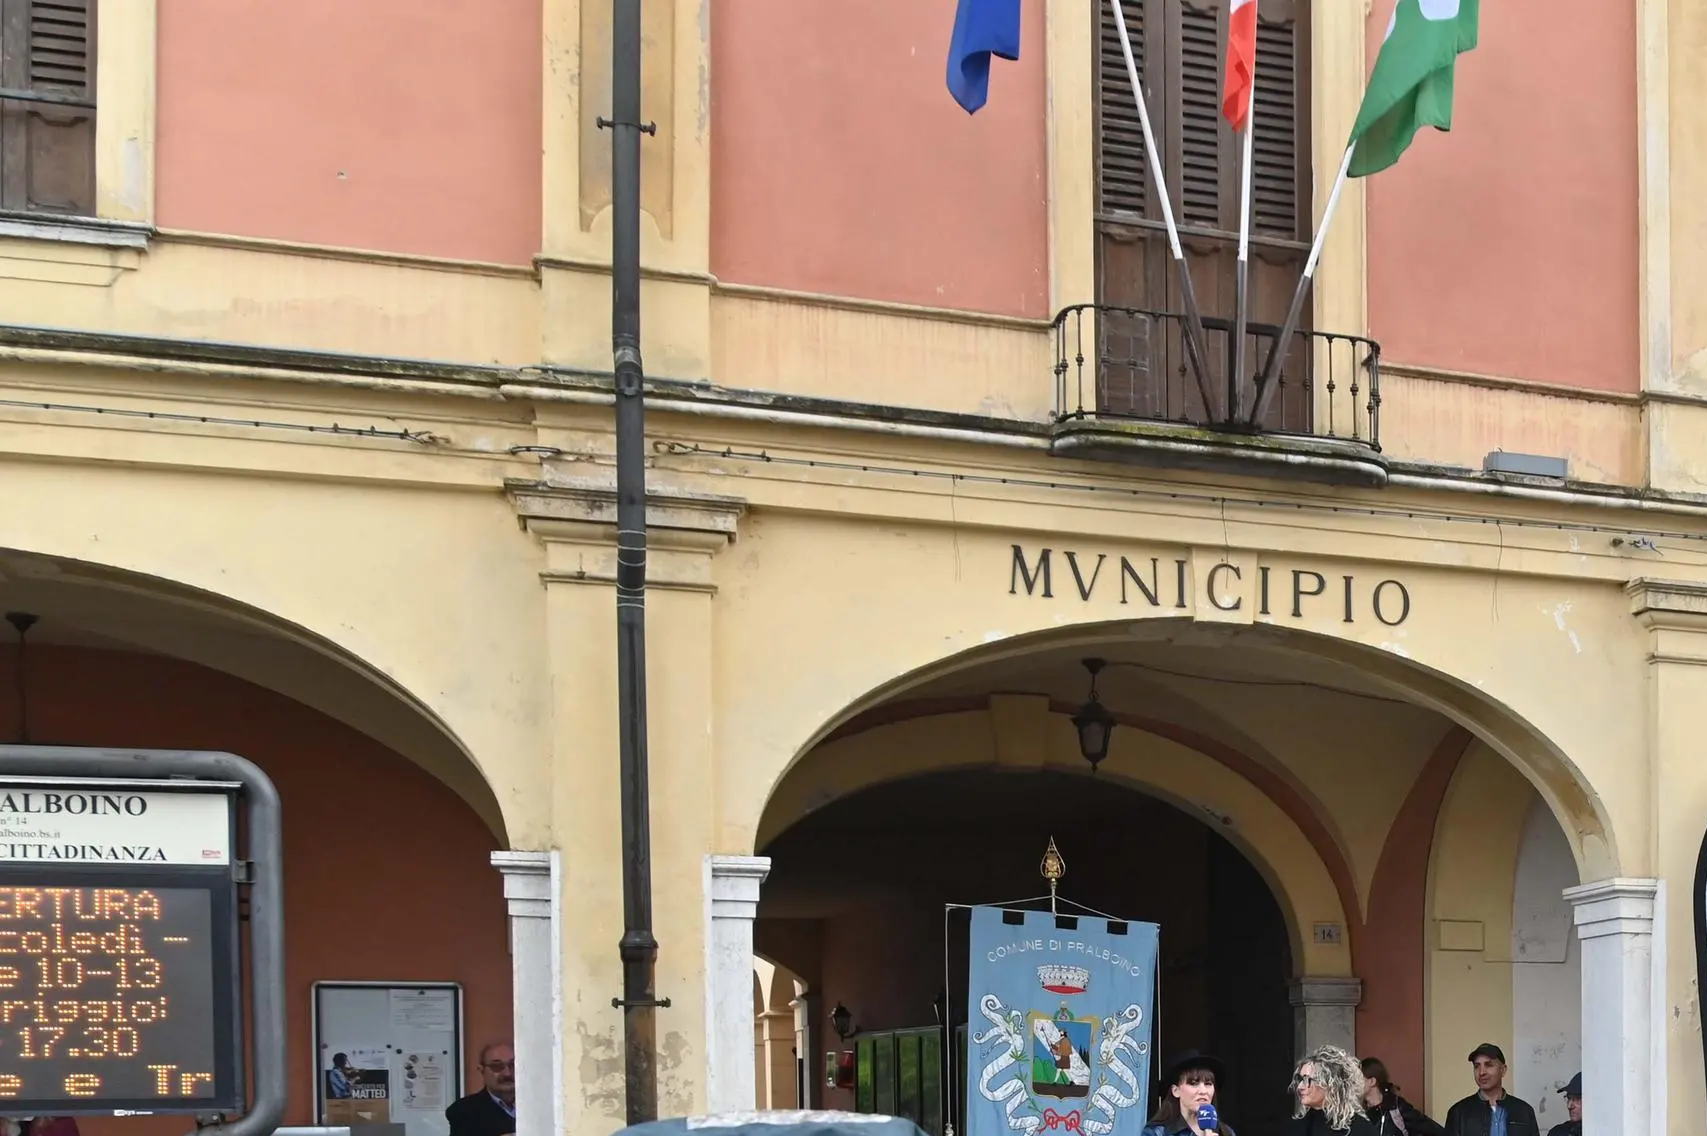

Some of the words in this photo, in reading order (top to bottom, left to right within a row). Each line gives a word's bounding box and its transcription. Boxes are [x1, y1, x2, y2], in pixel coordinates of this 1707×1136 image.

[1008, 544, 1411, 627] MVNICIPIO
[15, 816, 27, 825] 14
[986, 939, 1044, 963] COMUNE
[1049, 939, 1063, 951] DI
[1067, 940, 1142, 977] PRALBOINO
[19, 1026, 139, 1057] 17.30
[64, 1073, 101, 1096] e
